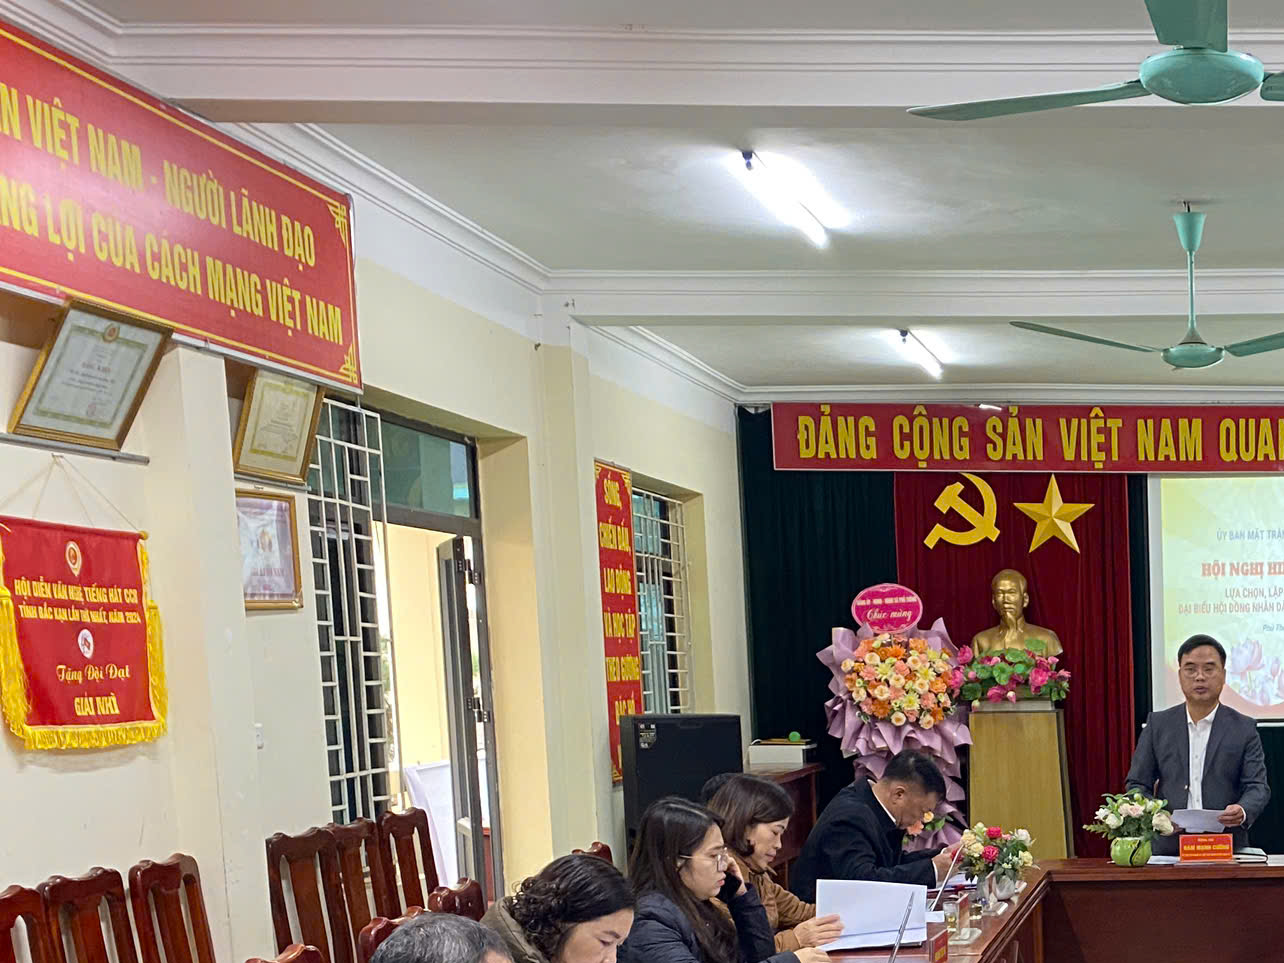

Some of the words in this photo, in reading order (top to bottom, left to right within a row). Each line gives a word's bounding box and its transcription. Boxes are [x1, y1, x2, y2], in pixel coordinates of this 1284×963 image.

[26, 96, 80, 170] VIỆT
[87, 123, 144, 192] NAM
[163, 159, 226, 229] NGƯỜI
[230, 188, 279, 251] LÃNH
[281, 213, 316, 272] ĐẠO
[44, 195, 86, 262] LỢI
[145, 230, 202, 295] CÁCH
[206, 256, 263, 318] MẠNG
[265, 276, 301, 337] VIỆT
[305, 295, 343, 346] NAM
[798, 405, 877, 460] ĐẢNG
[893, 405, 970, 468] CỘNG
[986, 407, 1043, 461] SẢN
[1059, 407, 1122, 469] VIỆT
[1137, 418, 1202, 461] NAM
[1229, 530, 1245, 540] BAN
[1201, 559, 1226, 580] HỘI
[1229, 561, 1264, 579] NGHỊ
[14, 576, 32, 600] HỘI
[52, 580, 69, 600] VĂN
[83, 582, 108, 603] TIẾNG
[108, 585, 123, 603] HÁT
[1225, 587, 1240, 600] LỰA
[1242, 587, 1267, 600] CHỌN,
[1269, 585, 1284, 599] LẬP
[38, 601, 54, 620] BẮC
[1213, 602, 1228, 616] HỘI
[1229, 601, 1251, 613] ĐỒNG
[1252, 600, 1275, 613] NHÂN
[56, 664, 83, 684] Tặng
[84, 663, 105, 683] Đội
[105, 663, 131, 682] Đạt
[74, 691, 96, 716] GIẢI
